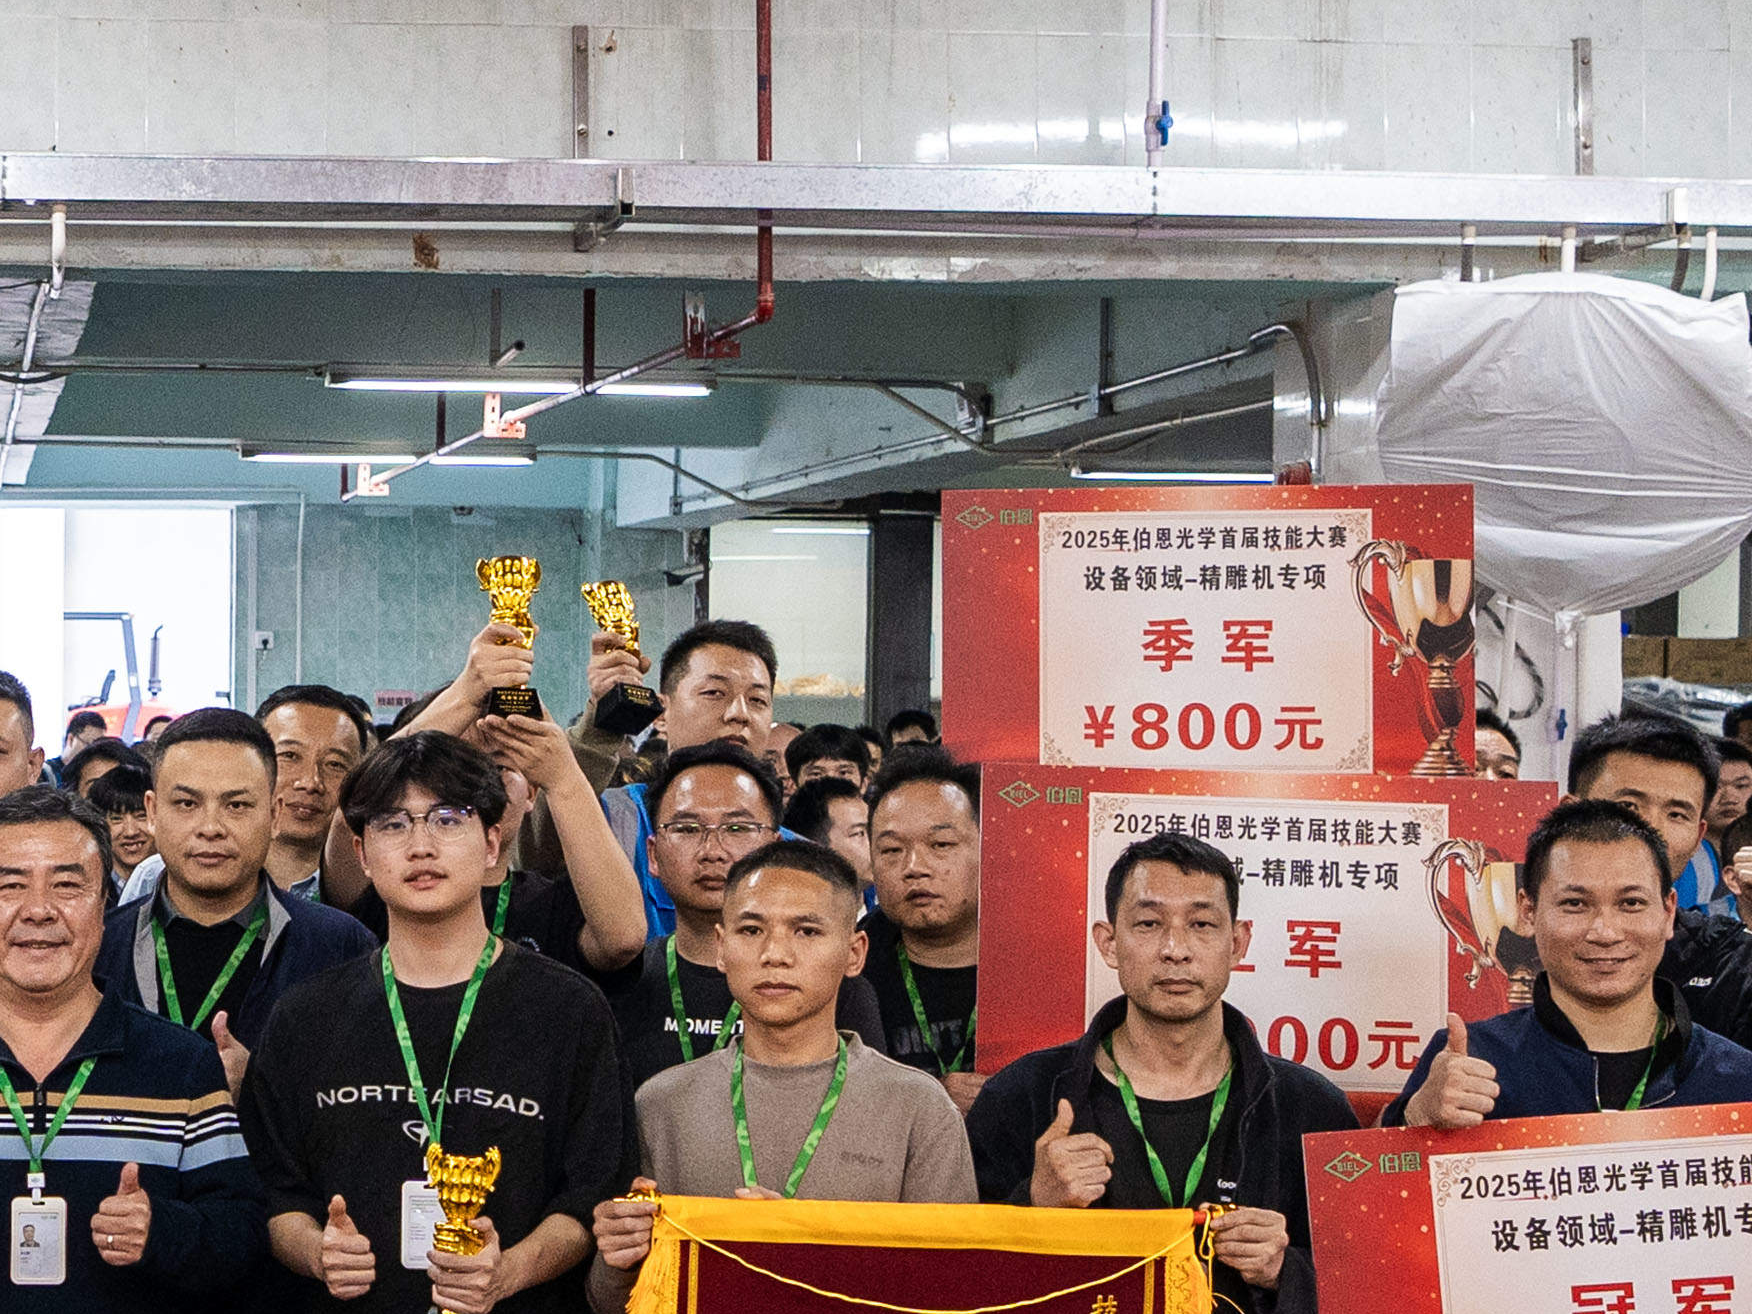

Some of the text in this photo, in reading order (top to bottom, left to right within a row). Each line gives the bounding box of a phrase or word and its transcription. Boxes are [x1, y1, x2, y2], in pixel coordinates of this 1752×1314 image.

[999, 508, 1033, 525] 伯恩
[1061, 525, 1348, 551] 2025年伯恩光学首届技能大赛
[1083, 564, 1327, 592] 设备领域-精雕机专项
[1141, 617, 1275, 673] 季军
[1046, 786, 1083, 804] 伯恩
[1113, 813, 1422, 847] 2025年伯恩光学首届技能大赛
[663, 1017, 745, 1035] MOMET
[1336, 1162, 1359, 1173] BIEL
[1378, 1151, 1422, 1174] 伯恩
